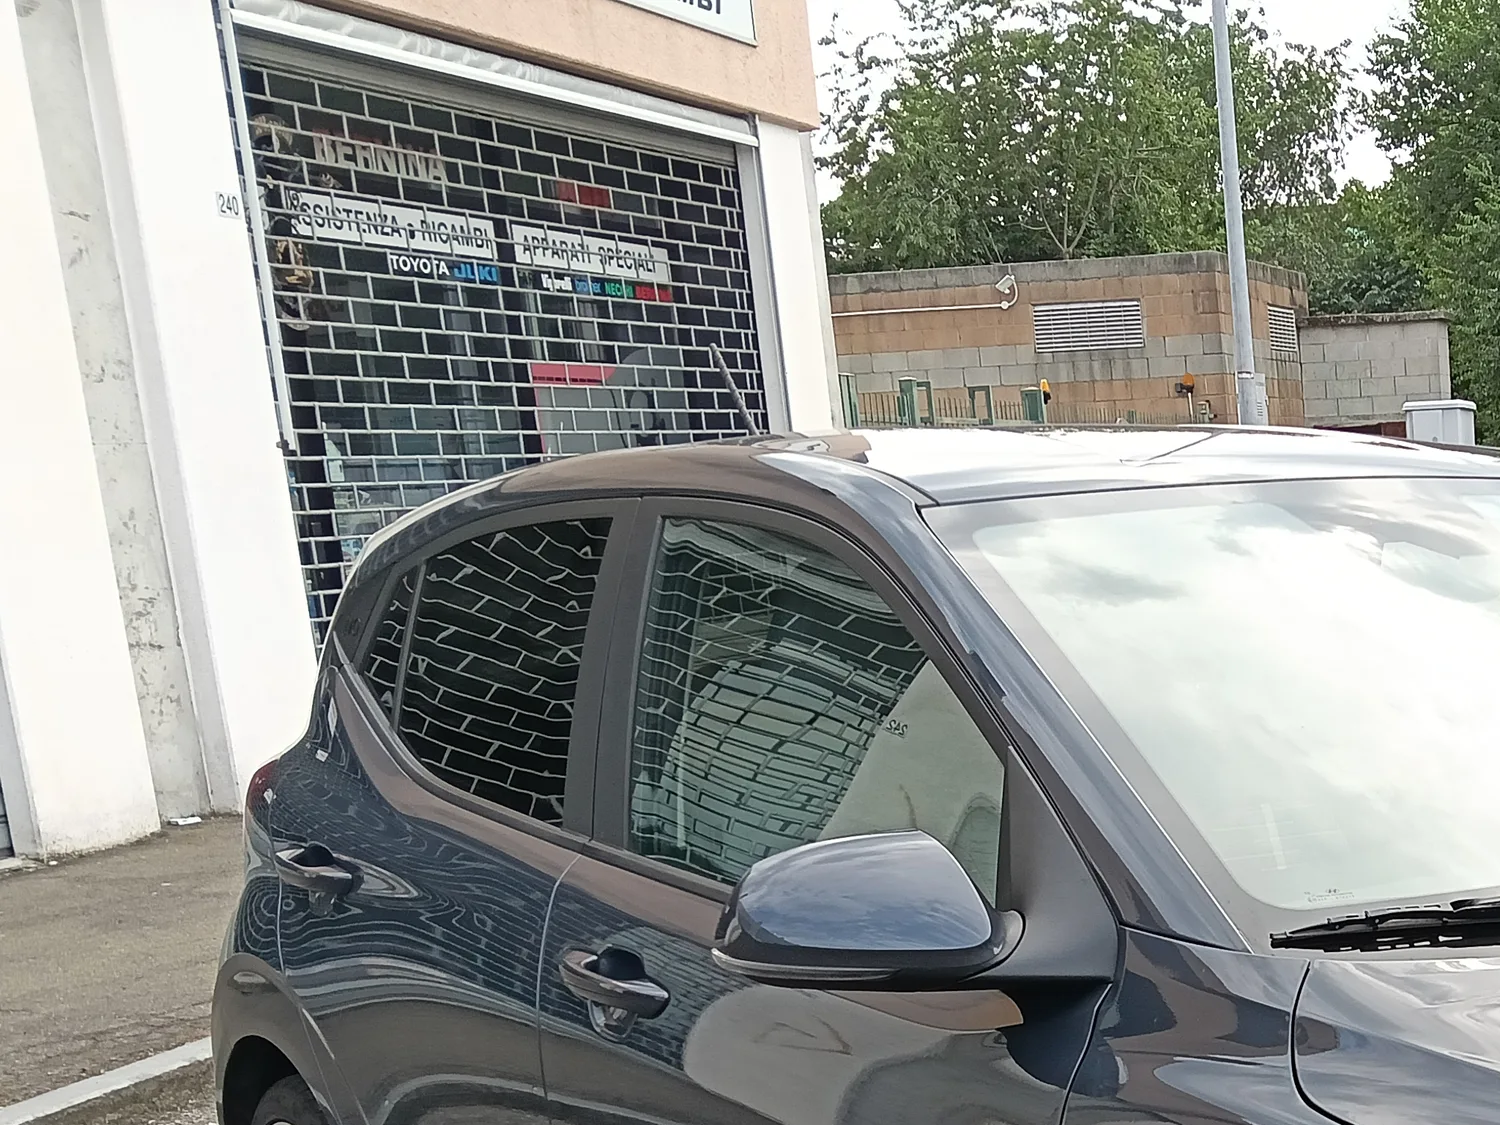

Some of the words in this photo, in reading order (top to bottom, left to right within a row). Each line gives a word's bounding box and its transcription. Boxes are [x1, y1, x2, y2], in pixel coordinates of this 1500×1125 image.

[219, 193, 239, 216] 240
[420, 219, 490, 250] RICAMBI
[390, 255, 451, 276] TOYOTA
[522, 234, 592, 264] APPARATI
[598, 246, 656, 274] SPECIALI
